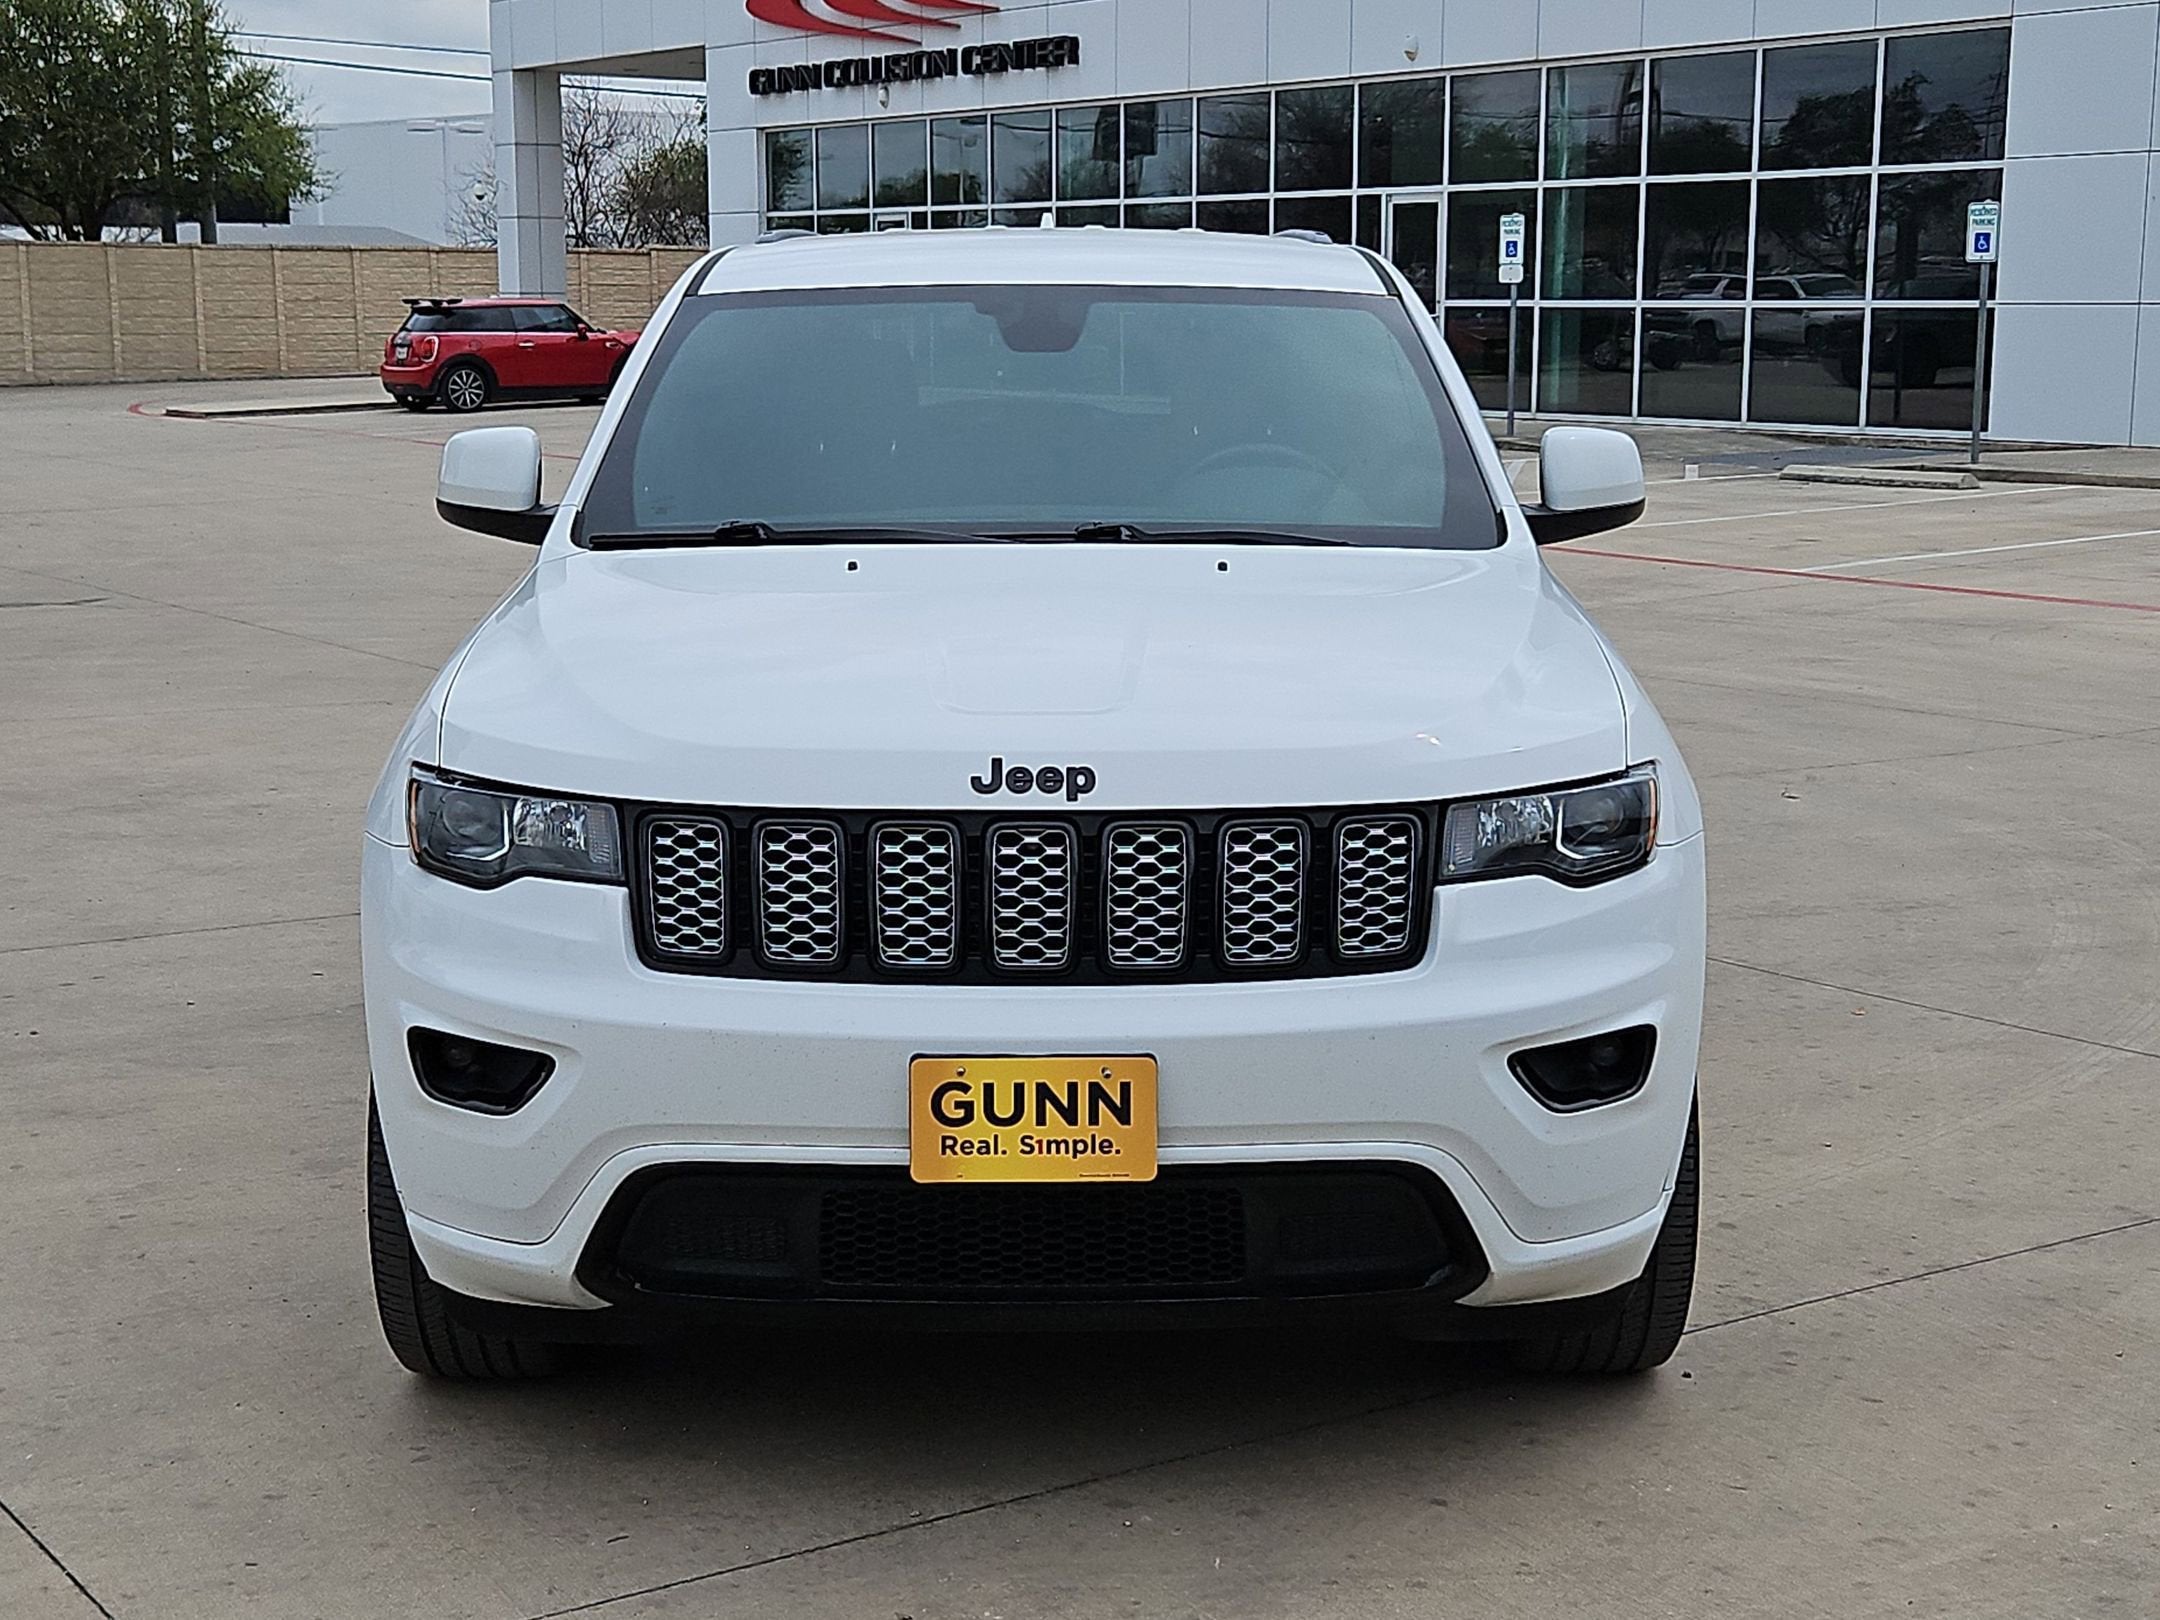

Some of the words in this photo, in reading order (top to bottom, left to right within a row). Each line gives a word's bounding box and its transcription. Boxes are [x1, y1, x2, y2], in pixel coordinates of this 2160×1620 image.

[749, 63, 822, 95] GUNN
[824, 48, 958, 88] COLLISION
[961, 36, 1080, 75] CENTER
[970, 757, 1096, 802] Jeep
[930, 1081, 1132, 1128] GUNN
[940, 1134, 1008, 1156] Real.
